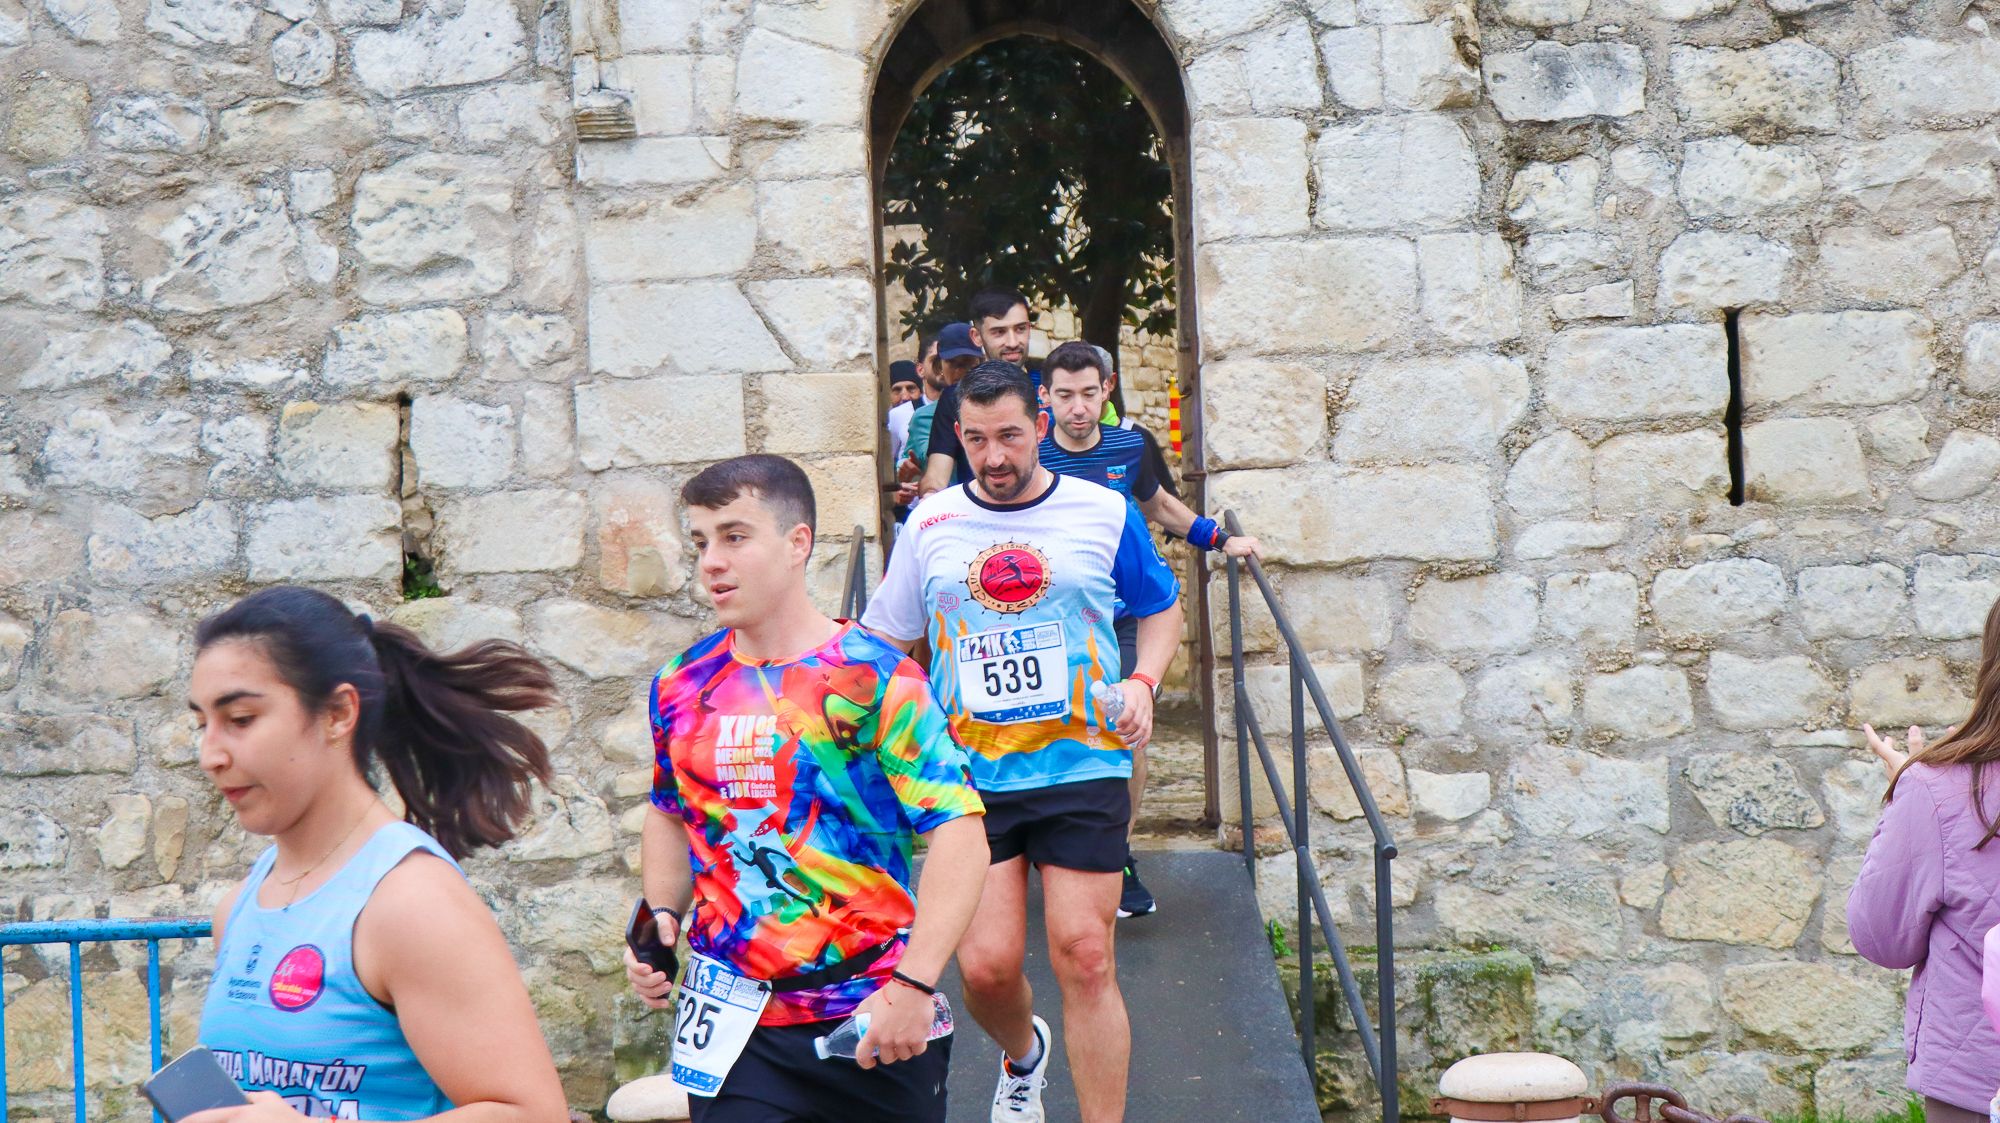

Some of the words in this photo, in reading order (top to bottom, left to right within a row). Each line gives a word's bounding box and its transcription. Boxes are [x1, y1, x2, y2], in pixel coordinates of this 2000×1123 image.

[983, 655, 1043, 697] 539
[716, 715, 756, 747] XII
[715, 748, 755, 765] MEDIA
[715, 761, 775, 782] MARATÓN
[727, 782, 751, 799] 10K
[212, 1050, 244, 1080] DIA
